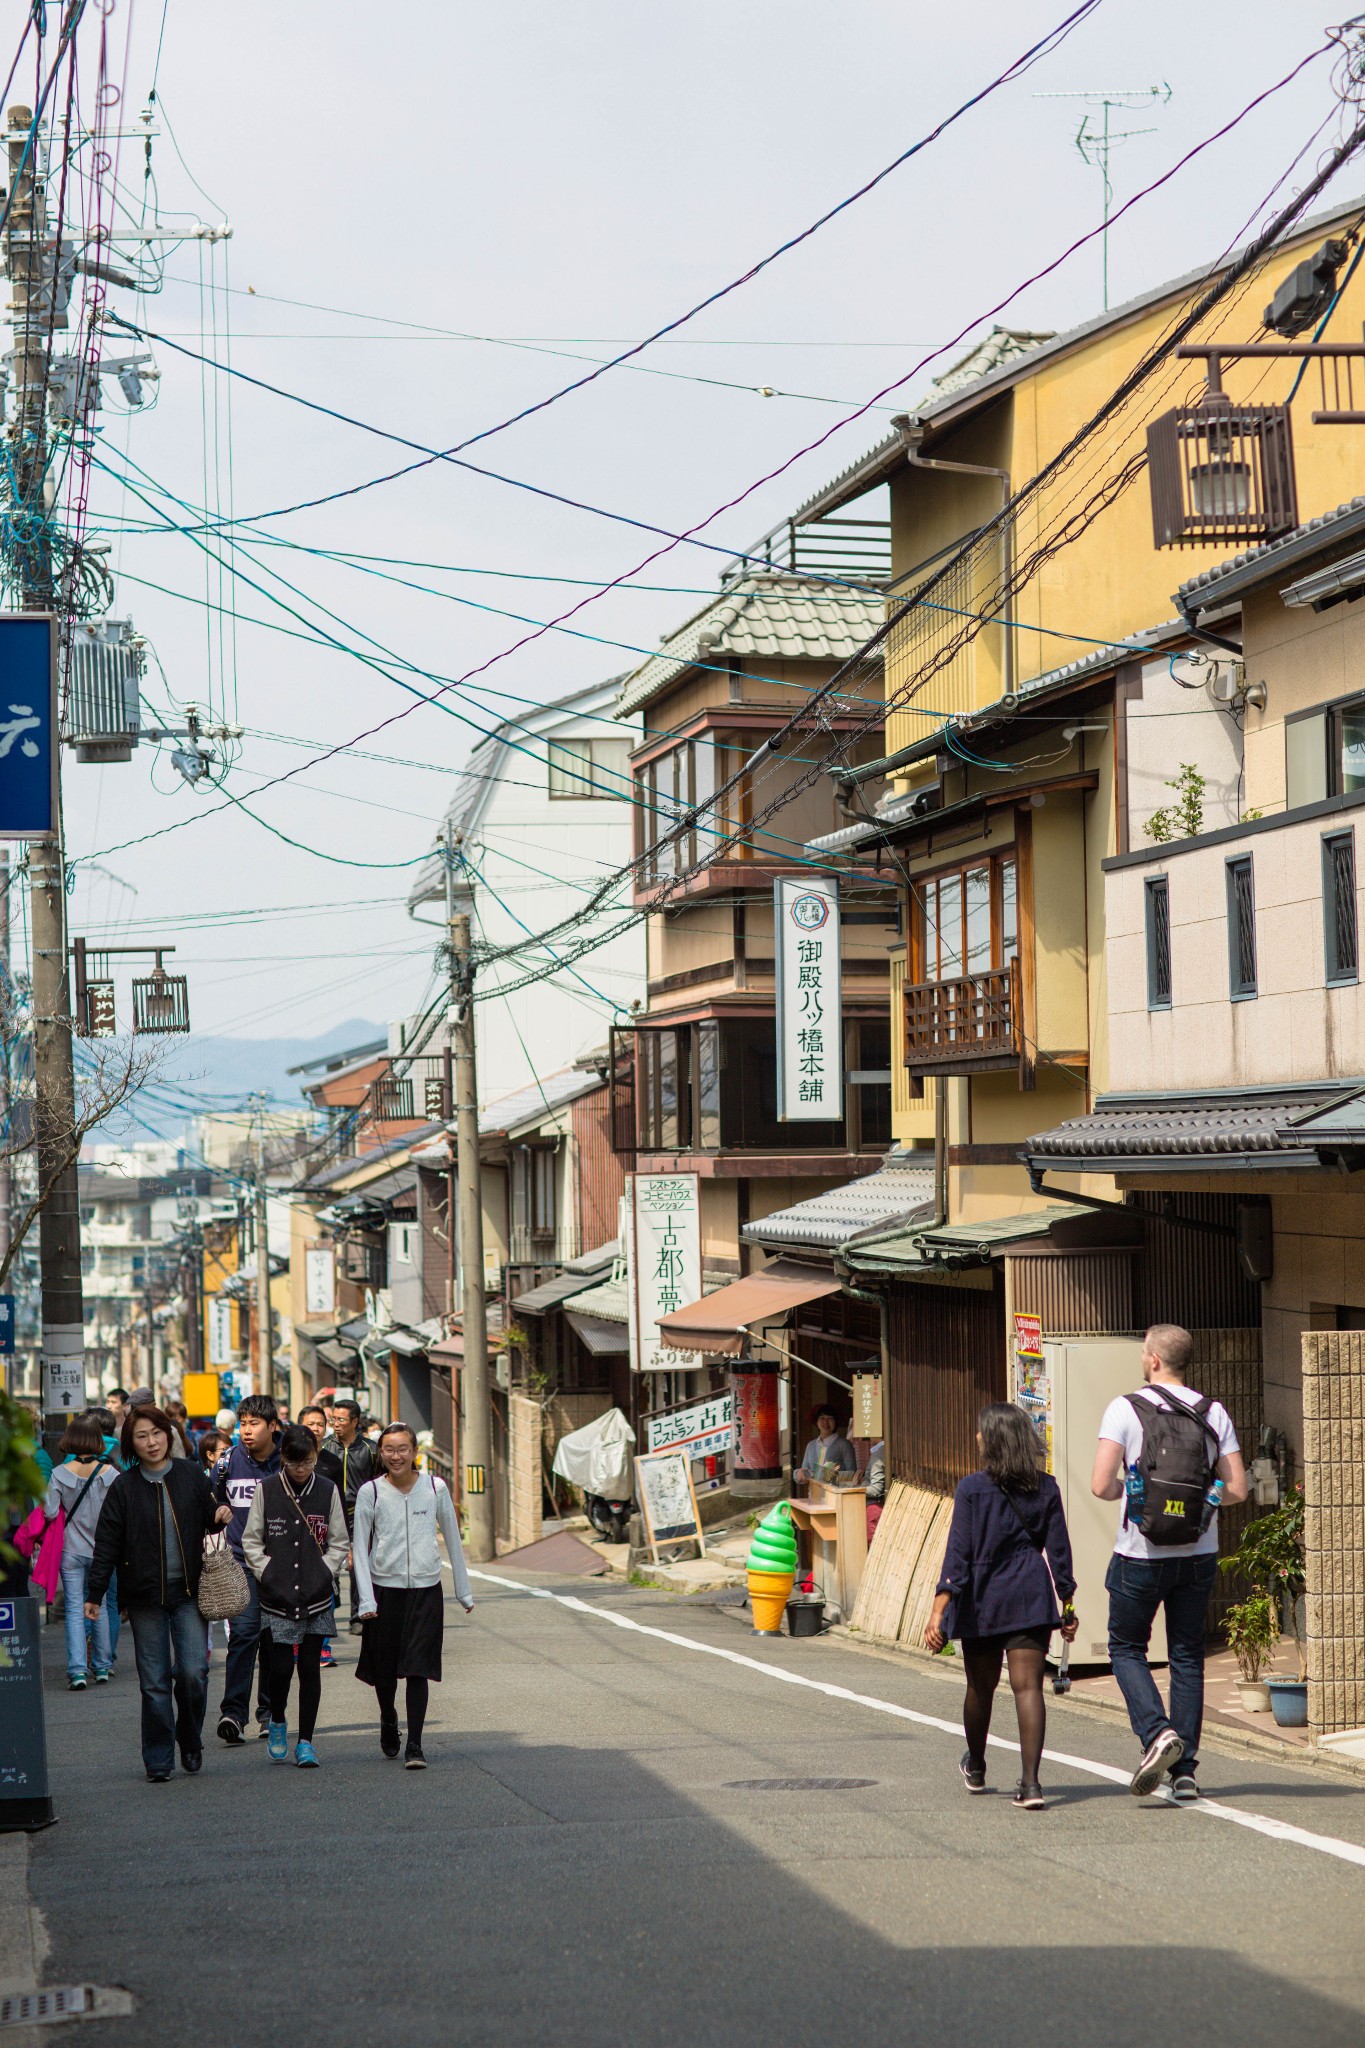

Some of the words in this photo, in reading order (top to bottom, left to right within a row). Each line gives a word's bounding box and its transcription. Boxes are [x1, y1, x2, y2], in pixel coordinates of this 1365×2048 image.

[649, 1181, 685, 1190] レストラン
[644, 1190, 691, 1200] コーヒーハウス
[649, 1201, 685, 1210] ペンション
[651, 1214, 686, 1316] 古都夢
[653, 1414, 694, 1435] コーヒー
[653, 1426, 695, 1447] レストラン
[1163, 1499, 1186, 1515] XXL
